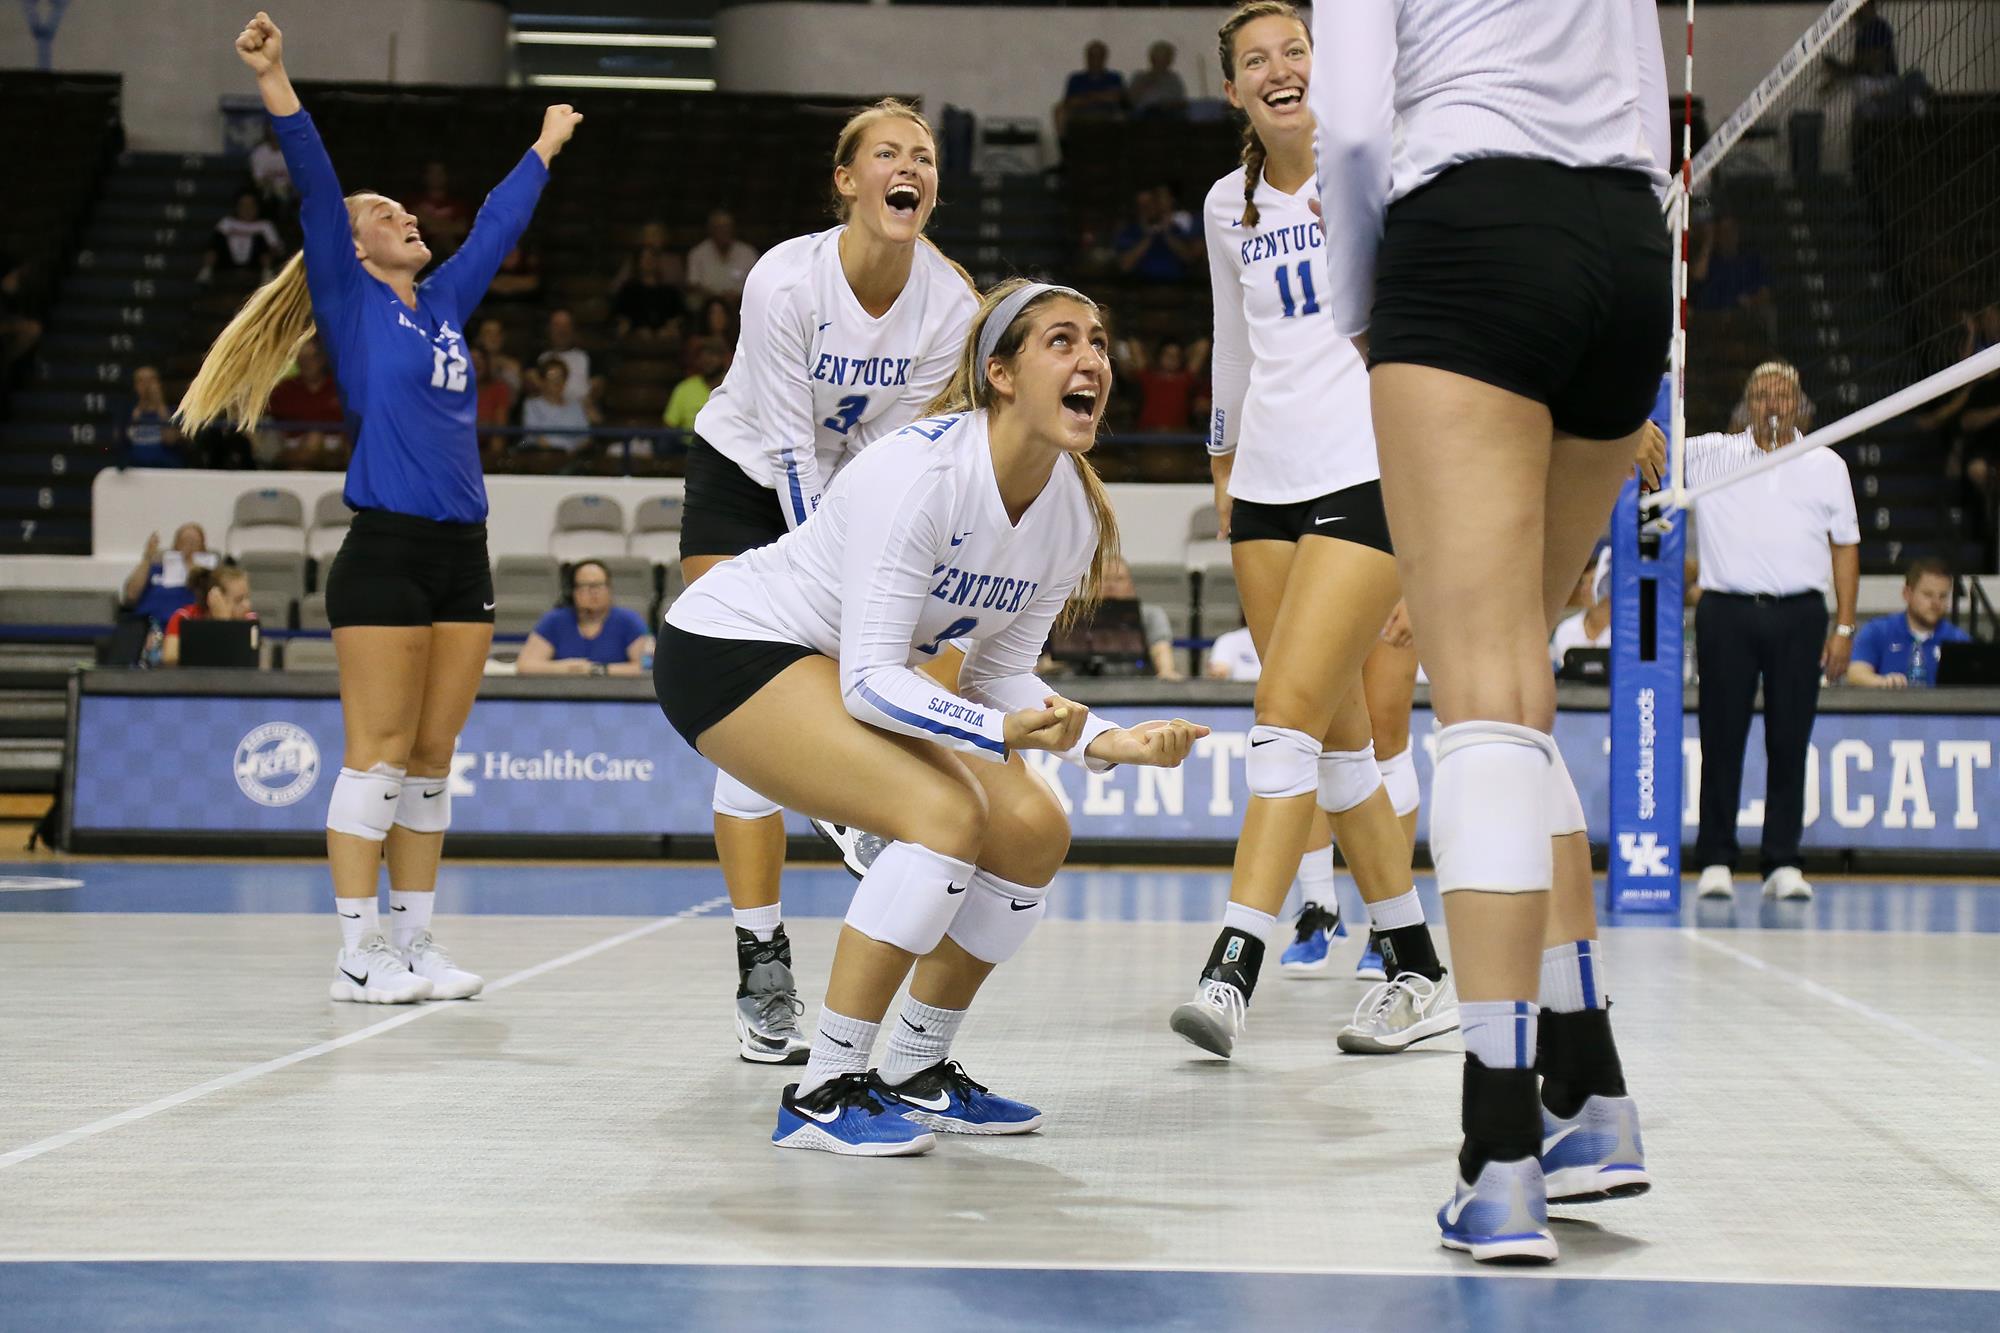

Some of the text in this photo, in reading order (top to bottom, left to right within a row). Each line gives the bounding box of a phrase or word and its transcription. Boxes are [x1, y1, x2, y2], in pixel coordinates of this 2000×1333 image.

[1241, 222, 1321, 265] KENTUC
[1275, 260, 1320, 319] 11
[96, 363, 121, 382] 12
[431, 344, 468, 393] 12
[812, 352, 911, 387] ENTUCK
[84, 393, 105, 411] 11
[822, 393, 870, 435] 3
[70, 424, 95, 444] 10
[51, 454, 67, 474] 9
[1857, 443, 1881, 466] 10
[20, 520, 37, 541] 7
[1876, 507, 1890, 530] 8
[1888, 542, 1902, 565] 7
[928, 697, 985, 727] WILDCATS
[484, 749, 654, 782] HealthCare
[1617, 831, 1670, 876] UK
